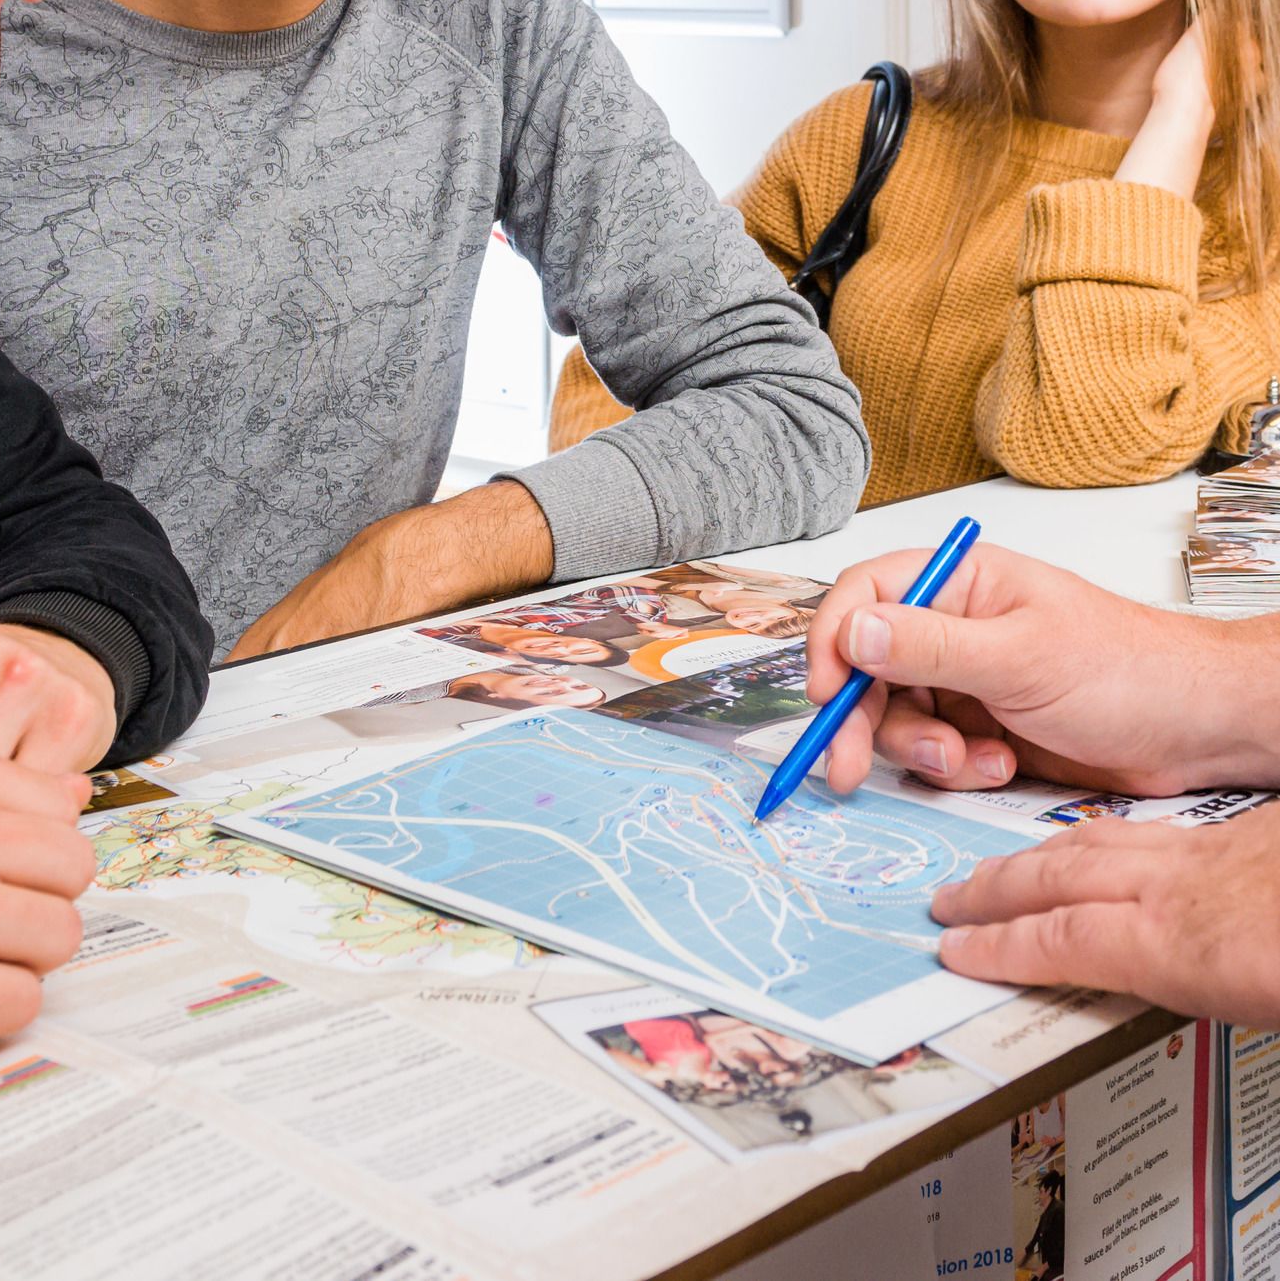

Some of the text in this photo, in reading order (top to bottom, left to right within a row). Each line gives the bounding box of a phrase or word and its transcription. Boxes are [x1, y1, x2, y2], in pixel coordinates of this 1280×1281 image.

[414, 990, 518, 1005] GERMANY
[1106, 1051, 1160, 1091] Vol-au-vent maison
[1110, 1092, 1116, 1103] et
[1117, 1083, 1131, 1098] frites
[1240, 1083, 1259, 1097] terrine
[1261, 1078, 1268, 1087] de
[1108, 1128, 1121, 1144] porc
[1121, 1117, 1138, 1132] sauce
[1139, 1097, 1167, 1120] moutarde
[1241, 1119, 1265, 1136] fromage
[1266, 1115, 1272, 1123] de
[1083, 1103, 1179, 1173] et gratin dauphinois & mix brocoli
[1242, 1133, 1263, 1149] salades
[1263, 1128, 1269, 1137] et
[1243, 1147, 1260, 1162] salade
[1261, 1143, 1267, 1151] de
[1092, 1187, 1112, 1205] Gyros
[1143, 1149, 1169, 1170] légumes
[1243, 1160, 1260, 1175] sauces
[1083, 1250, 1104, 1266] sauce
[1104, 1244, 1112, 1253] au
[1112, 1236, 1121, 1247] vin
[1139, 1211, 1158, 1231] purée
[1158, 1196, 1180, 1215] maison
[1102, 1224, 1115, 1239] Filet
[1115, 1218, 1122, 1229] de
[1122, 1207, 1138, 1222] truite
[973, 1247, 1014, 1269] 2018
[1120, 1263, 1138, 1280] pâtes
[1139, 1257, 1144, 1268] 3
[1144, 1245, 1166, 1264] sauces
